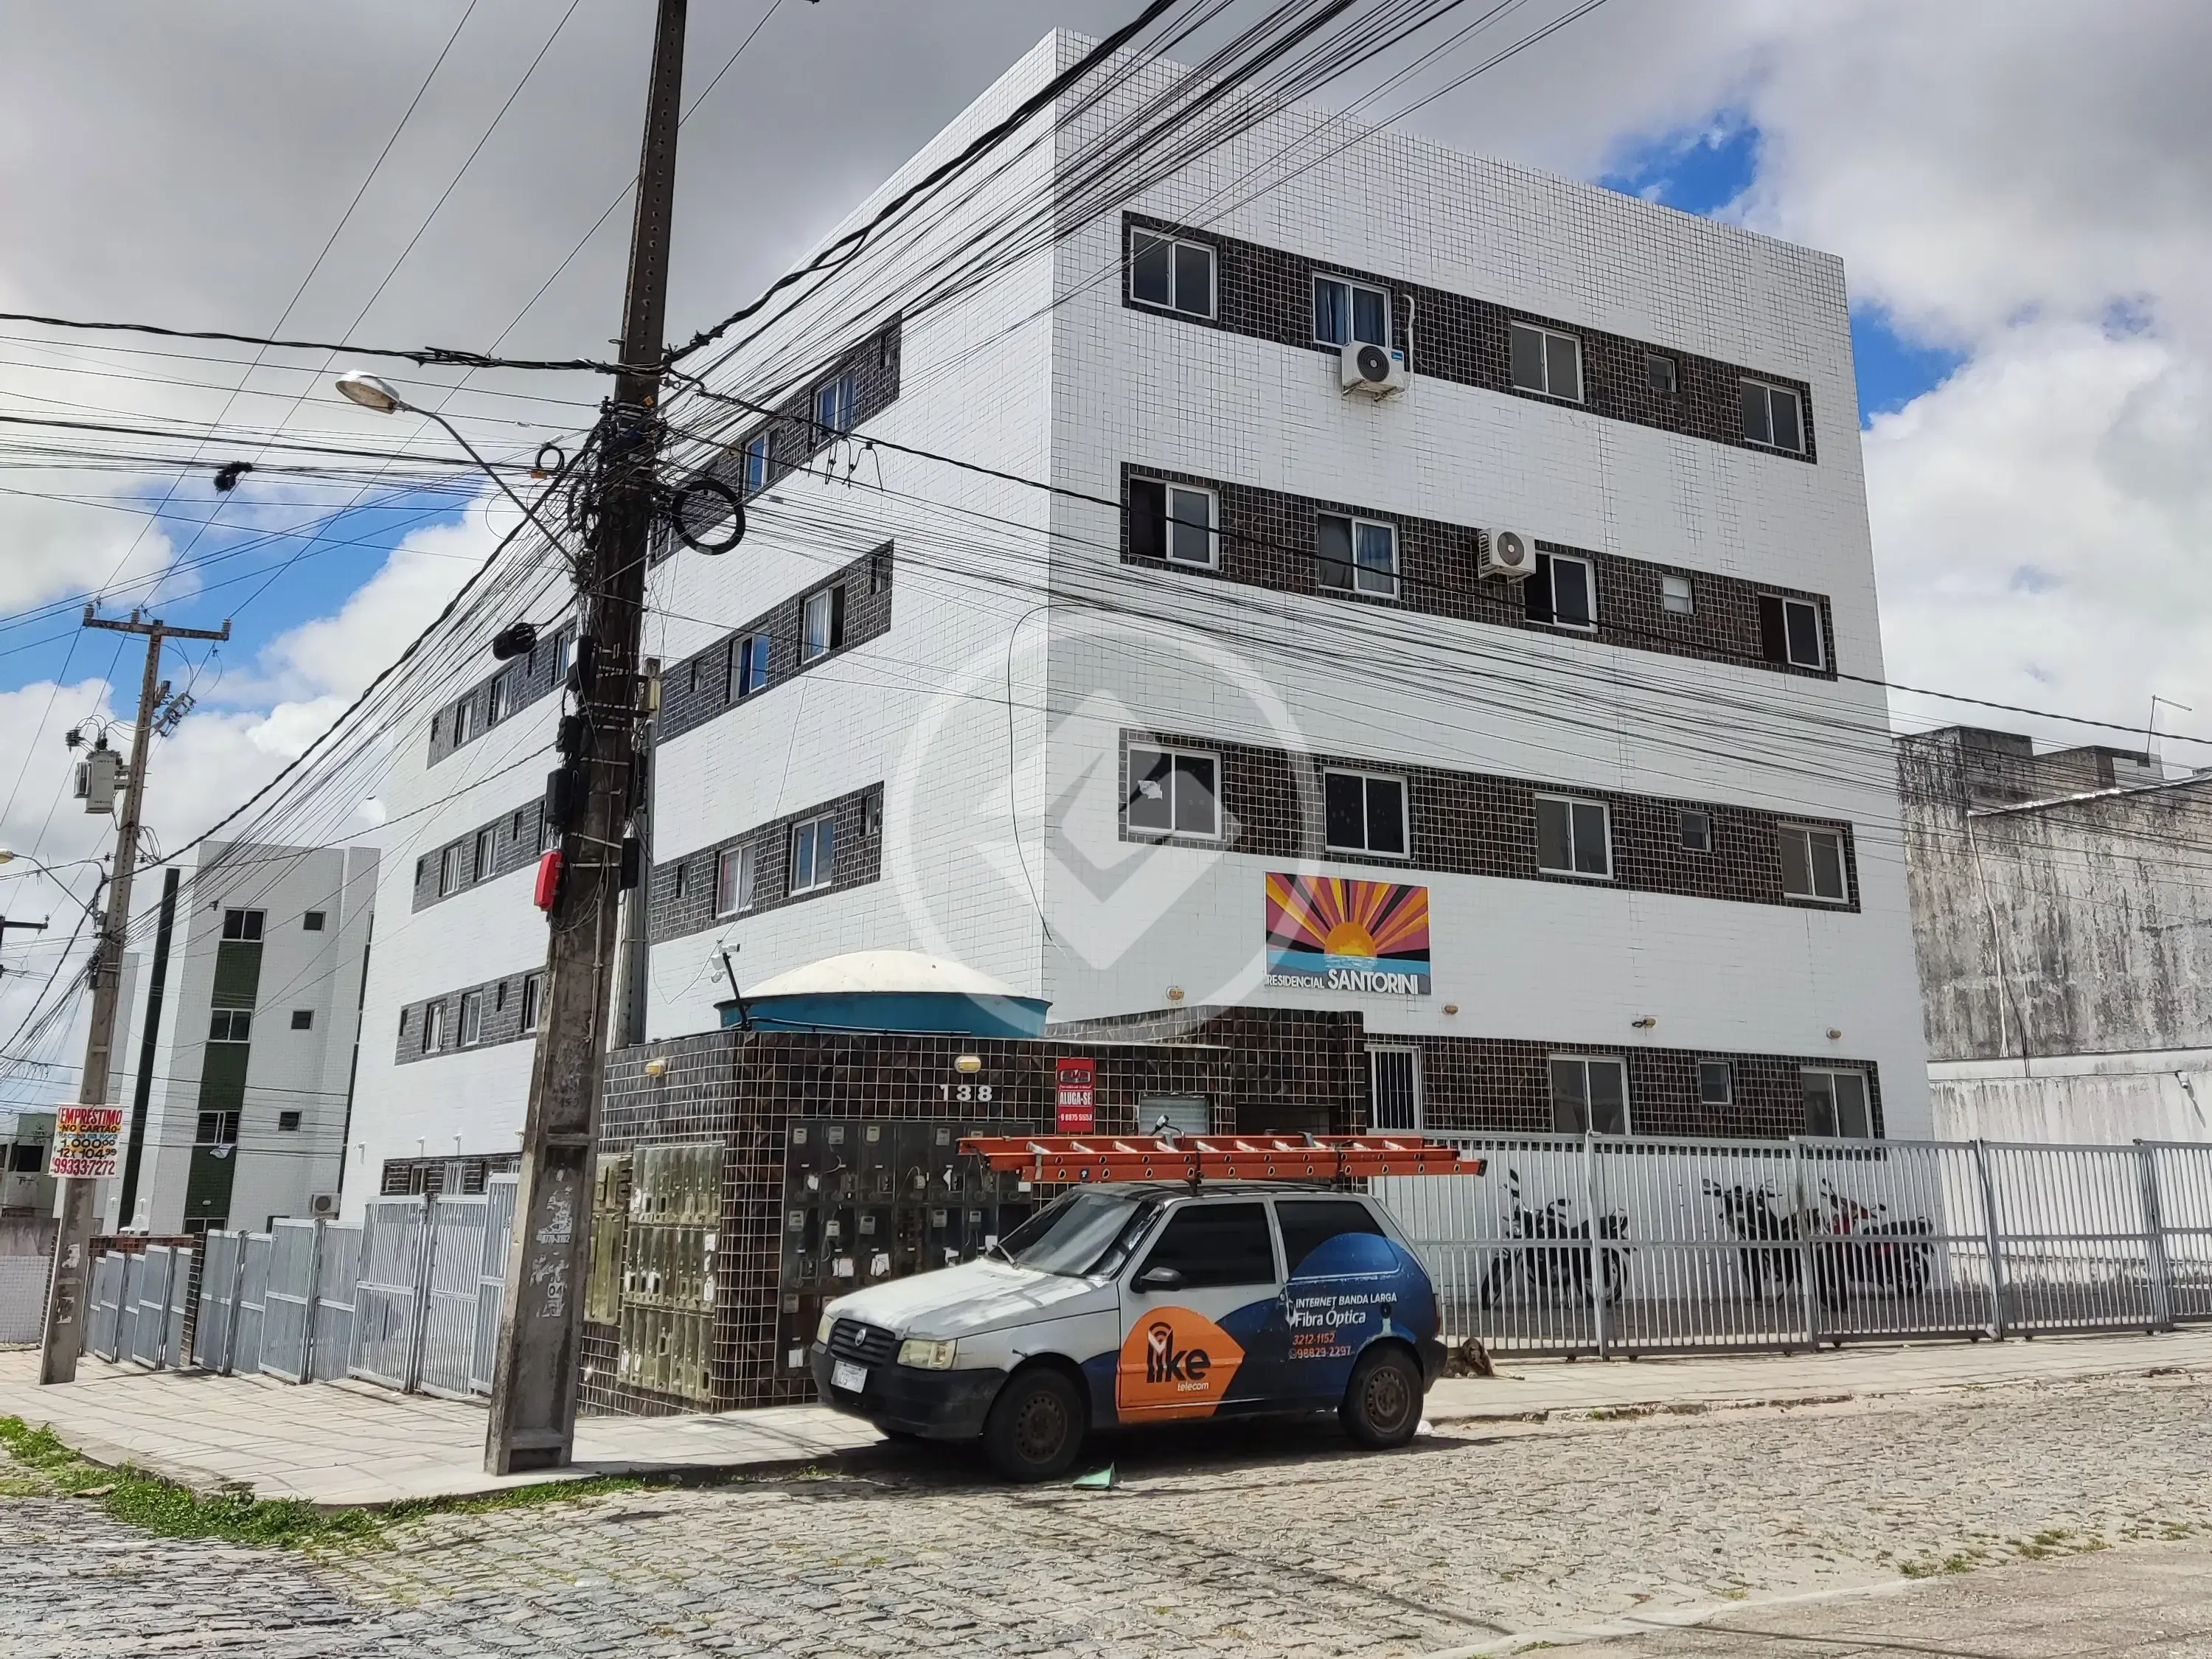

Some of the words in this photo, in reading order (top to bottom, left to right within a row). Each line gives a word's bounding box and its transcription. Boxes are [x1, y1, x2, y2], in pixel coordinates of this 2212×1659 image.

[1267, 974, 1325, 989] RESIDENCIAL
[1327, 968, 1419, 995] SANTORINI
[939, 1084, 992, 1102] 138
[1060, 1091, 1091, 1105] ALUGA-SE
[60, 1107, 123, 1125] EMPRÉSTIMO
[1295, 1296, 1338, 1309] INTERNET
[1338, 1295, 1368, 1306] BANDA
[1370, 1292, 1397, 1304] LARGA
[1295, 1310, 1324, 1327] Fibra
[1326, 1306, 1366, 1328] Óptica
[1177, 1382, 1209, 1392] telecom
